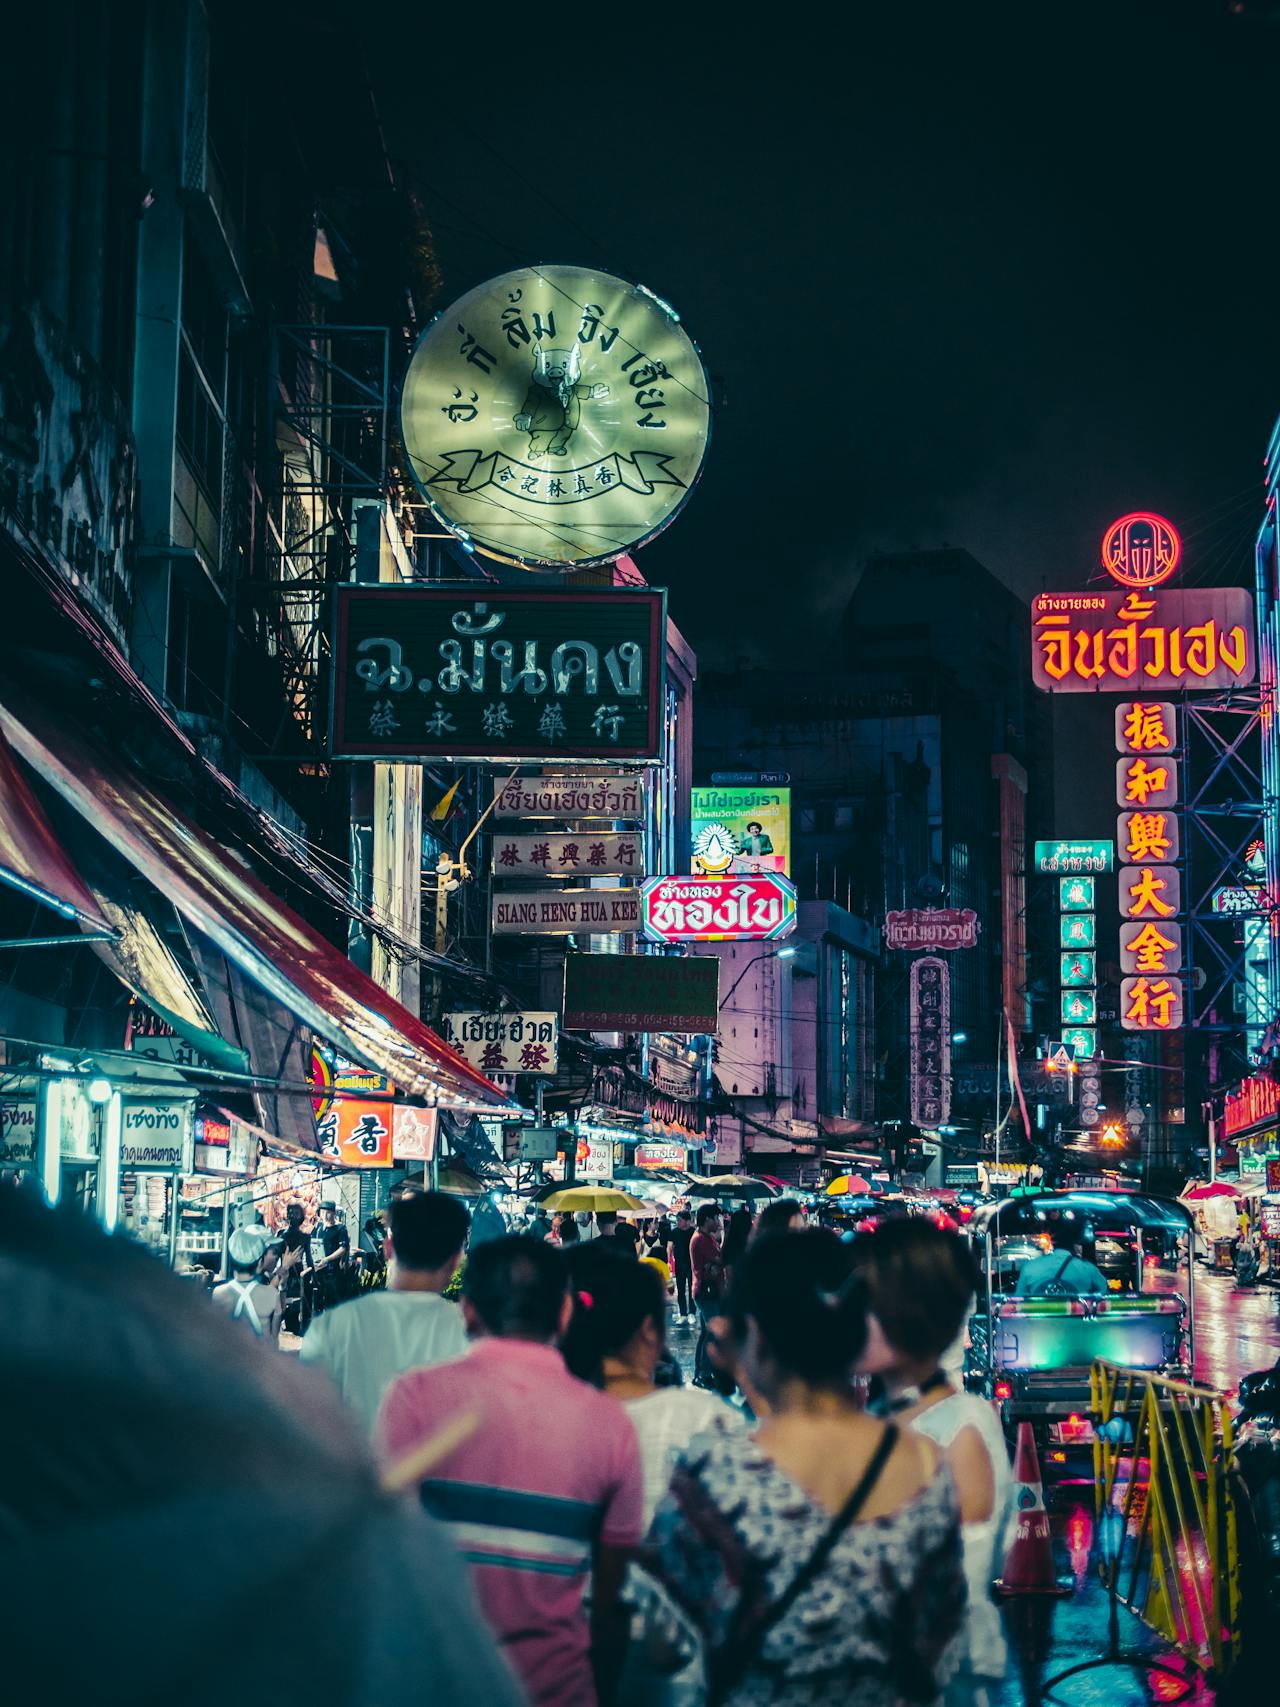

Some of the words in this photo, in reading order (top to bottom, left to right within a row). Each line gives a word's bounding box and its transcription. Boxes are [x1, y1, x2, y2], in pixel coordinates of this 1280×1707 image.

[1036, 593, 1107, 611] ห้างขายทอง
[1035, 592, 1246, 681] จินฮั้วเฮง
[1123, 702, 1178, 1029] 振和興大金行
[652, 884, 780, 931] ทองใบ
[659, 881, 723, 900] ห้างทอง
[497, 903, 537, 924] SIANG
[540, 902, 576, 923] HENG
[580, 901, 608, 922] HUA
[611, 900, 638, 921] KEE
